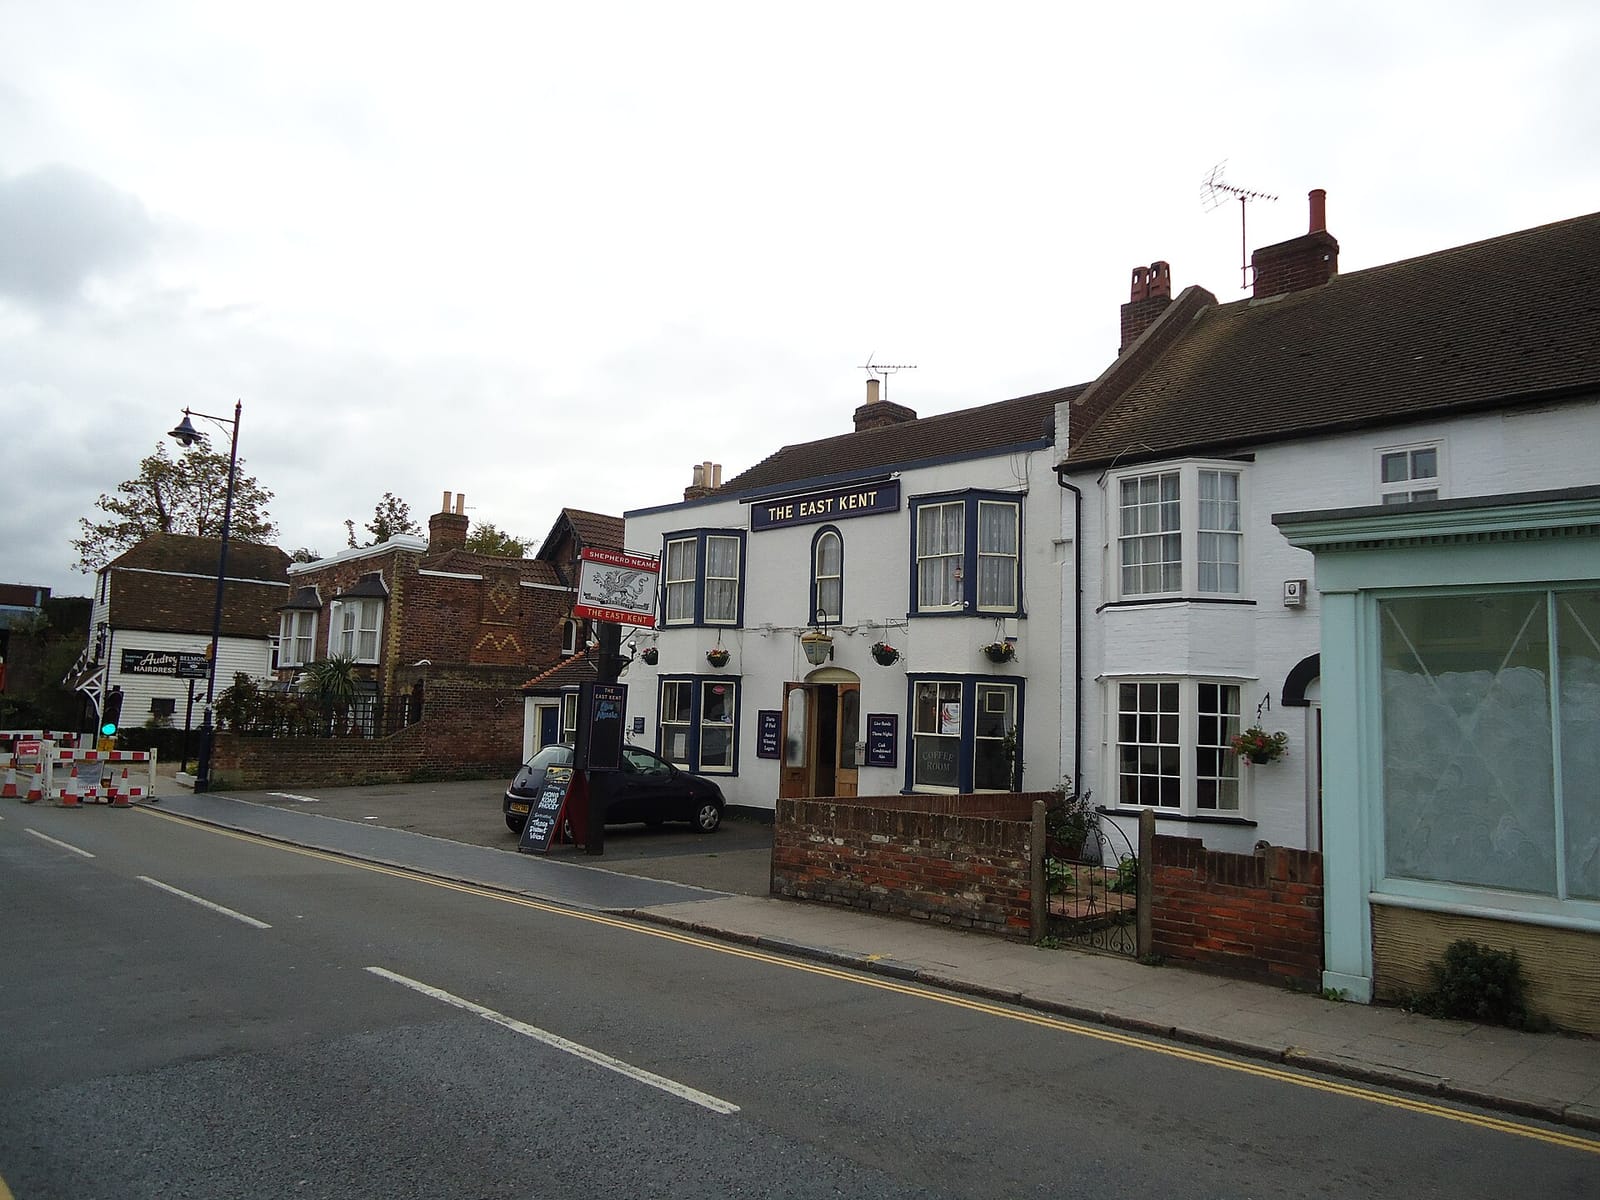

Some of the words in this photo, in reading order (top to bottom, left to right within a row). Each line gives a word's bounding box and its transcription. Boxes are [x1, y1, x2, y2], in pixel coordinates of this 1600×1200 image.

[768, 505, 794, 521] THE
[799, 498, 834, 517] EAST
[839, 491, 878, 511] KENT
[589, 551, 630, 564] SHEPHERD
[631, 559, 657, 569] NEAME
[587, 608, 603, 617] THE
[605, 611, 625, 621] EAST
[627, 614, 648, 624] KENT
[140, 652, 178, 667] Audrey
[922, 751, 954, 762] COFFEE
[927, 761, 951, 772] ROOM
